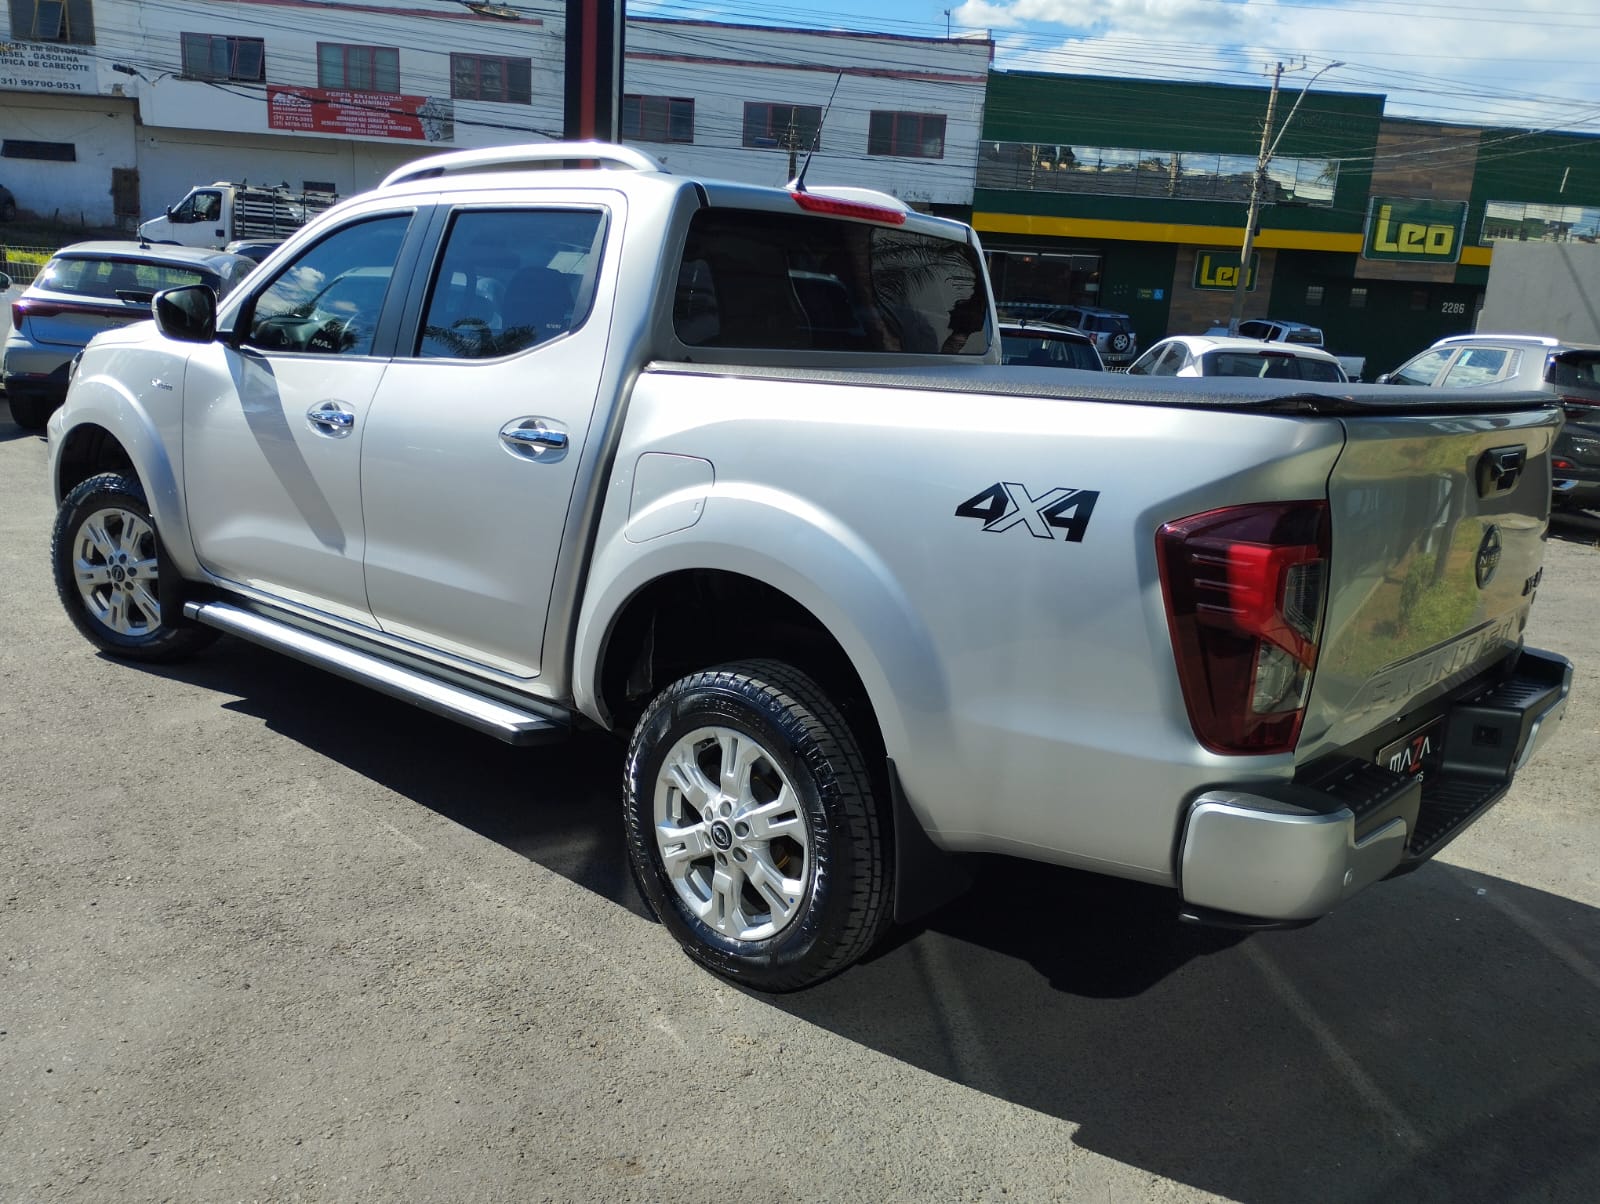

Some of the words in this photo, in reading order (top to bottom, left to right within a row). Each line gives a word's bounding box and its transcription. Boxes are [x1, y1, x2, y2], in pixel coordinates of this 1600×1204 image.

[33, 53, 79, 62] GASOLINA
[42, 62, 89, 71] CABEÇOTE
[1375, 205, 1455, 255] Leo
[1442, 302, 1465, 313] 2286
